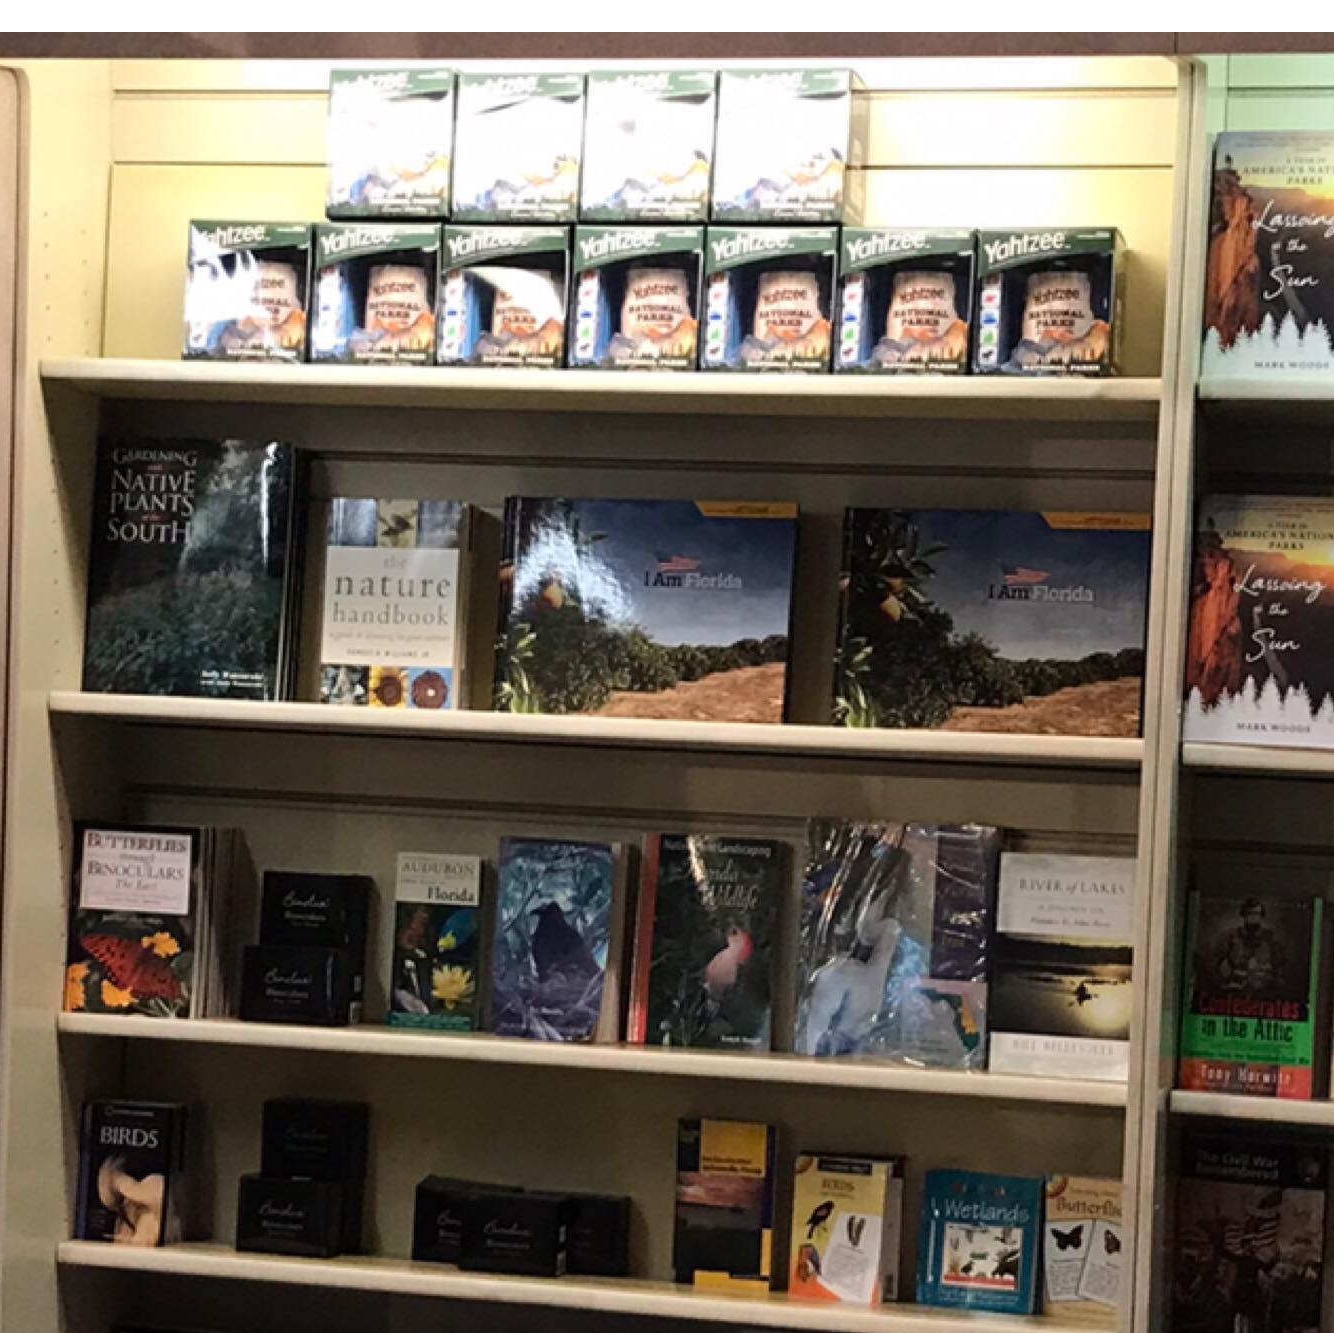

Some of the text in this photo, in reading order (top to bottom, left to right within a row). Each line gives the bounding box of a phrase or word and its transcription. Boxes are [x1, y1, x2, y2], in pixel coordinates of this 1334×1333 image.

[580, 233, 656, 260] Yahtzee
[711, 233, 790, 262] Yahtzee
[847, 233, 926, 263] Yahtzee
[984, 232, 1065, 263] Yahtzee
[111, 470, 195, 493] NATIVE
[109, 492, 194, 515] PLANTS
[107, 519, 190, 544] SOUTH
[333, 571, 451, 599] nature
[332, 603, 449, 626] handbook
[87, 832, 188, 853] BUTTERFLIES
[86, 861, 185, 881] BINOCULARS
[401, 862, 474, 875] AUDUBON
[426, 887, 475, 902] Florida
[100, 1125, 159, 1149] BIRDS
[944, 1198, 1030, 1223] Wetlands
